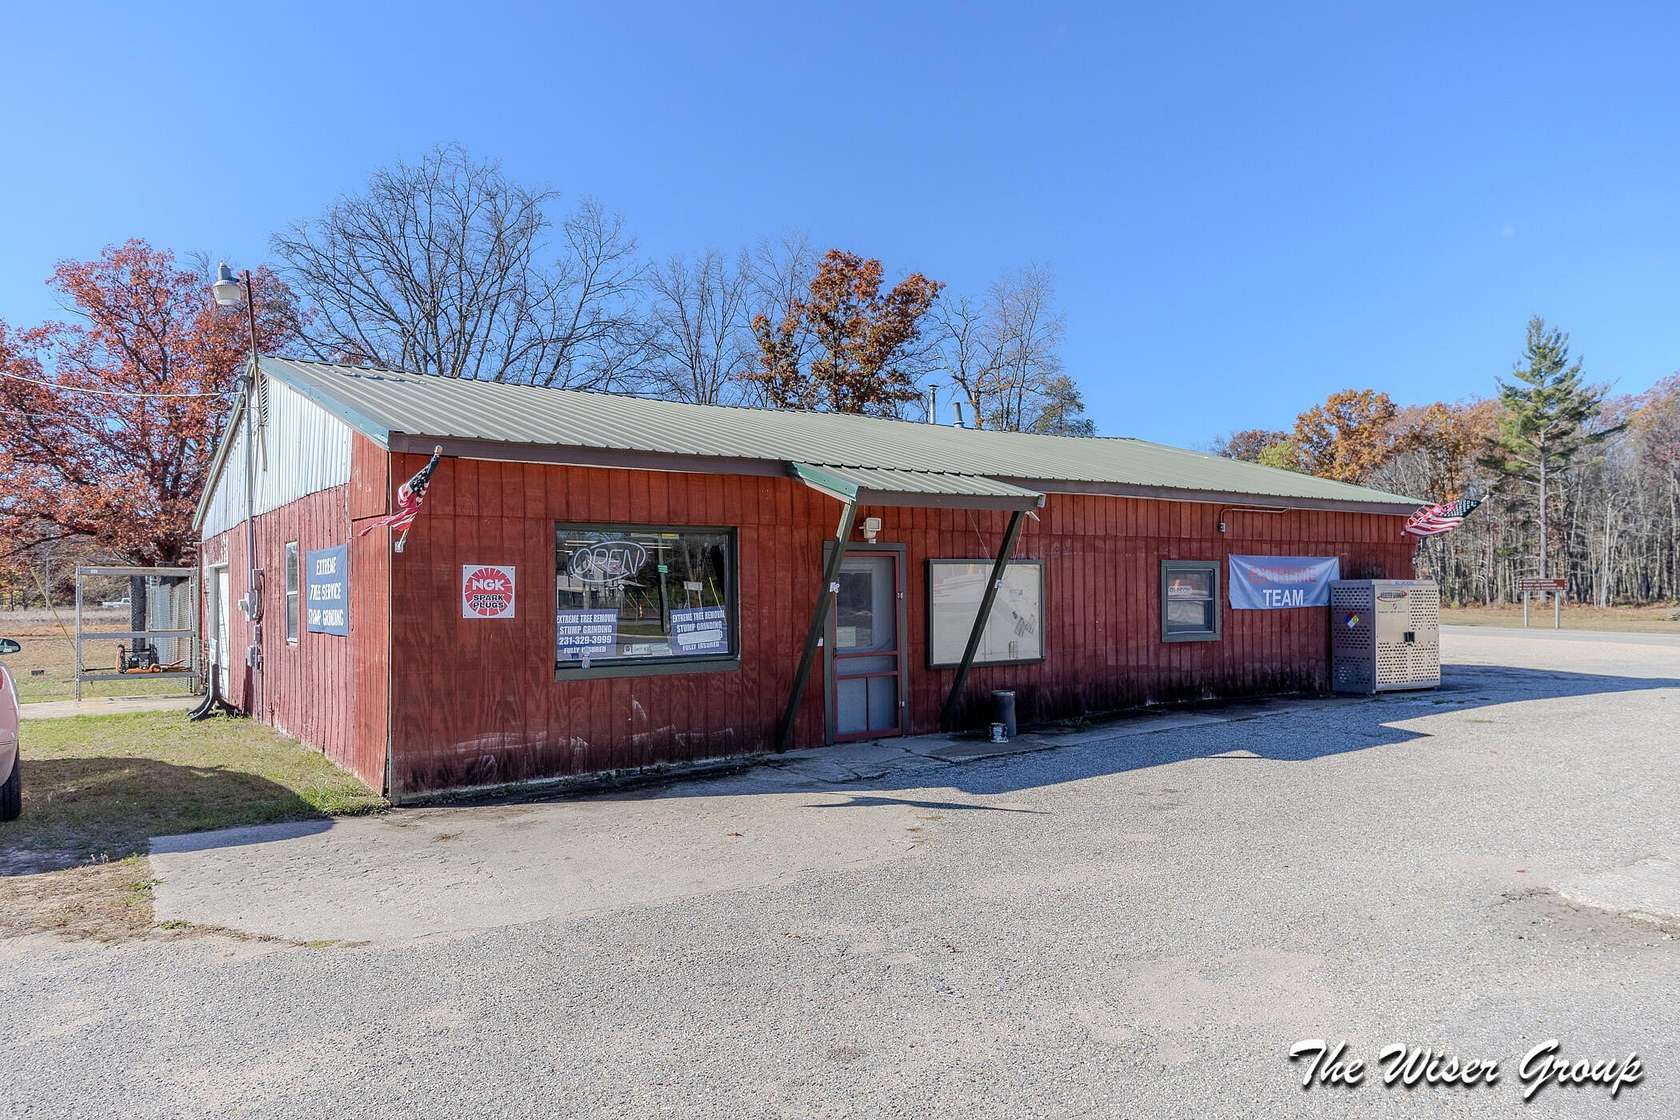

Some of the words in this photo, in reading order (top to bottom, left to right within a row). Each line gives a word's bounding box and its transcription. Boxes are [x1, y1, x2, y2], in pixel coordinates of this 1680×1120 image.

[316, 557, 337, 575] EXTREME
[574, 549, 640, 575] OPEN
[310, 584, 321, 600] TREE
[321, 582, 341, 600] SERVICE
[472, 579, 504, 591] NGK
[1263, 589, 1304, 606] TEAM
[322, 608, 344, 626] GRINDING
[557, 615, 579, 623] EXTREME
[580, 615, 592, 623] TREE
[593, 613, 616, 623] REMOVAL
[672, 613, 693, 622] EXTREME
[693, 612, 704, 621] TREE
[560, 626, 581, 635] STUMP
[583, 625, 612, 634] GRINDING
[677, 624, 696, 633] STUMP
[697, 621, 722, 631] GRINDING
[559, 636, 612, 645] 231-329-3999
